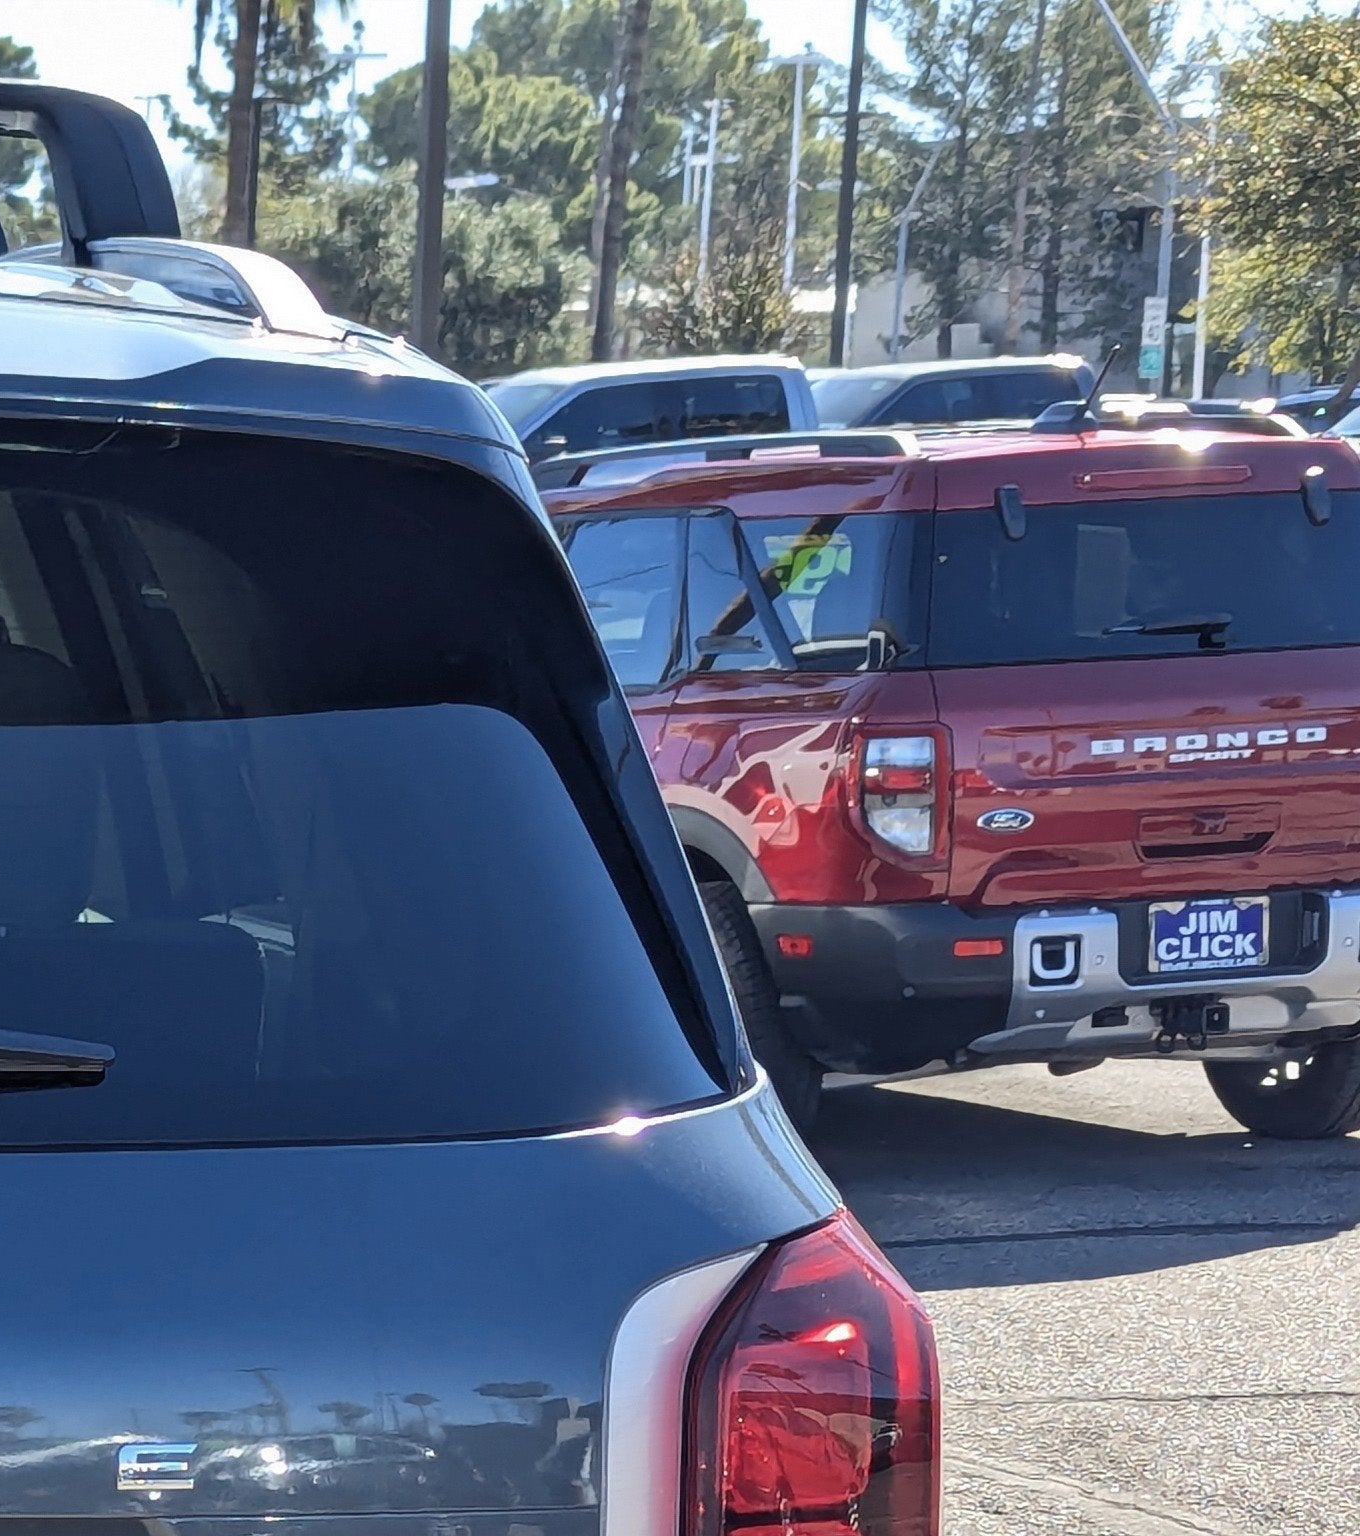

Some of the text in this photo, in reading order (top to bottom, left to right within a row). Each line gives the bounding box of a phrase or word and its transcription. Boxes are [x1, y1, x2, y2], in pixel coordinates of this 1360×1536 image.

[1090, 726, 1327, 755] BRONCO
[1179, 909, 1238, 935] JIM
[1157, 932, 1258, 960] CLICK
